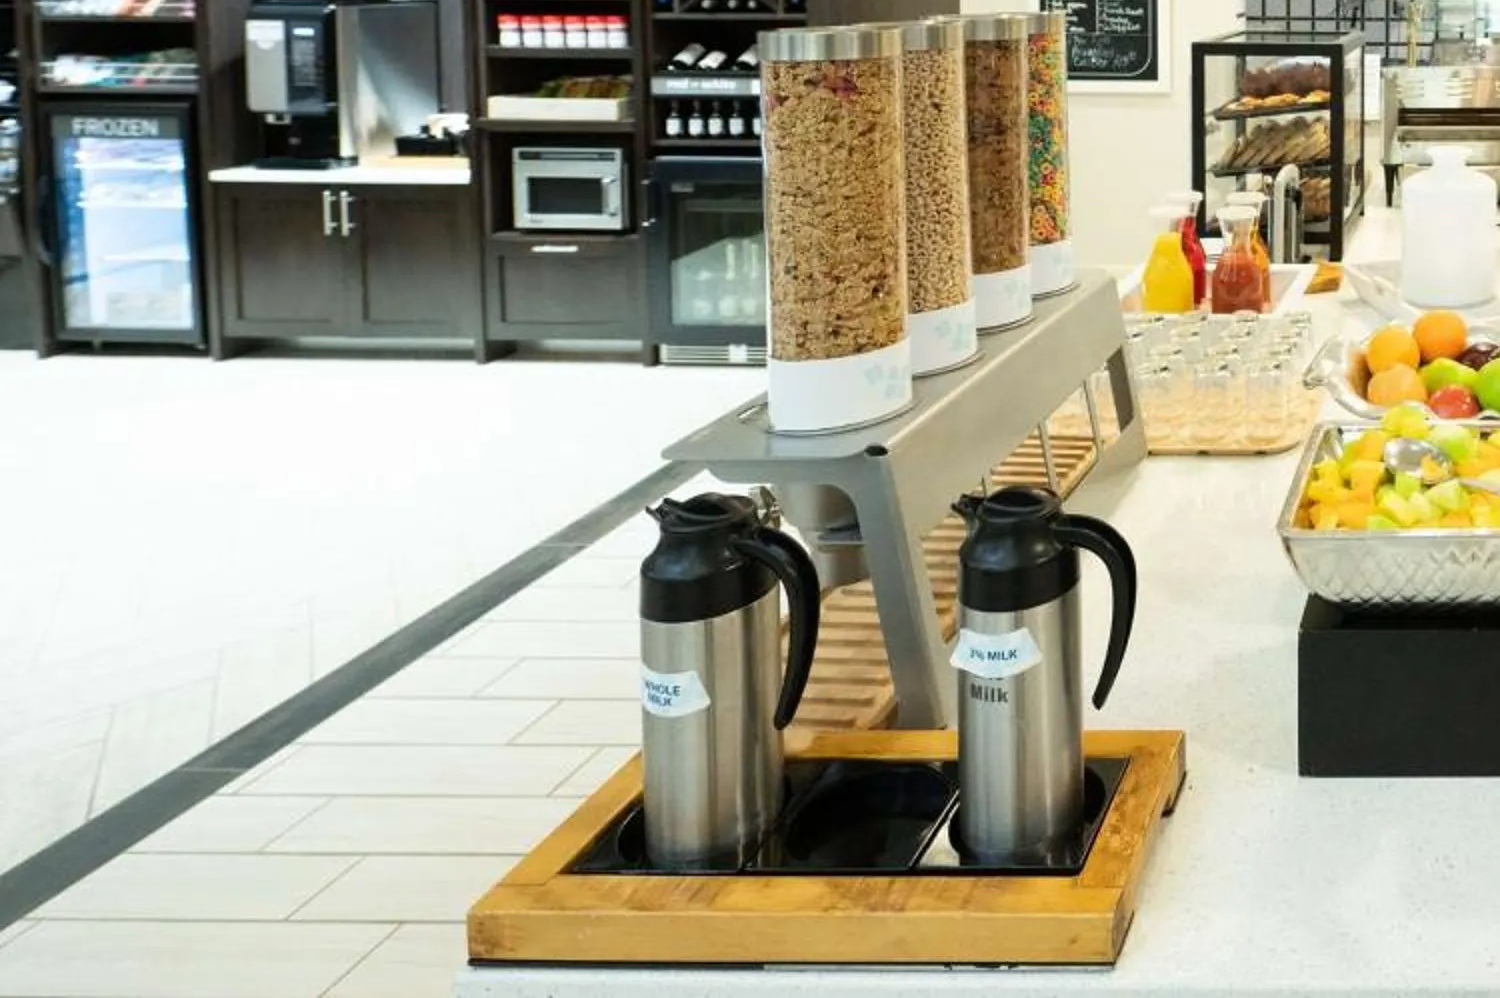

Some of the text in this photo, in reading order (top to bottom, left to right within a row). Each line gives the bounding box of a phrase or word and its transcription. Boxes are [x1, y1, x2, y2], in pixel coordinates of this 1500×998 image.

[72, 117, 159, 136] FROZEN
[987, 649, 1018, 661] MILK
[970, 683, 1009, 703] Milk
